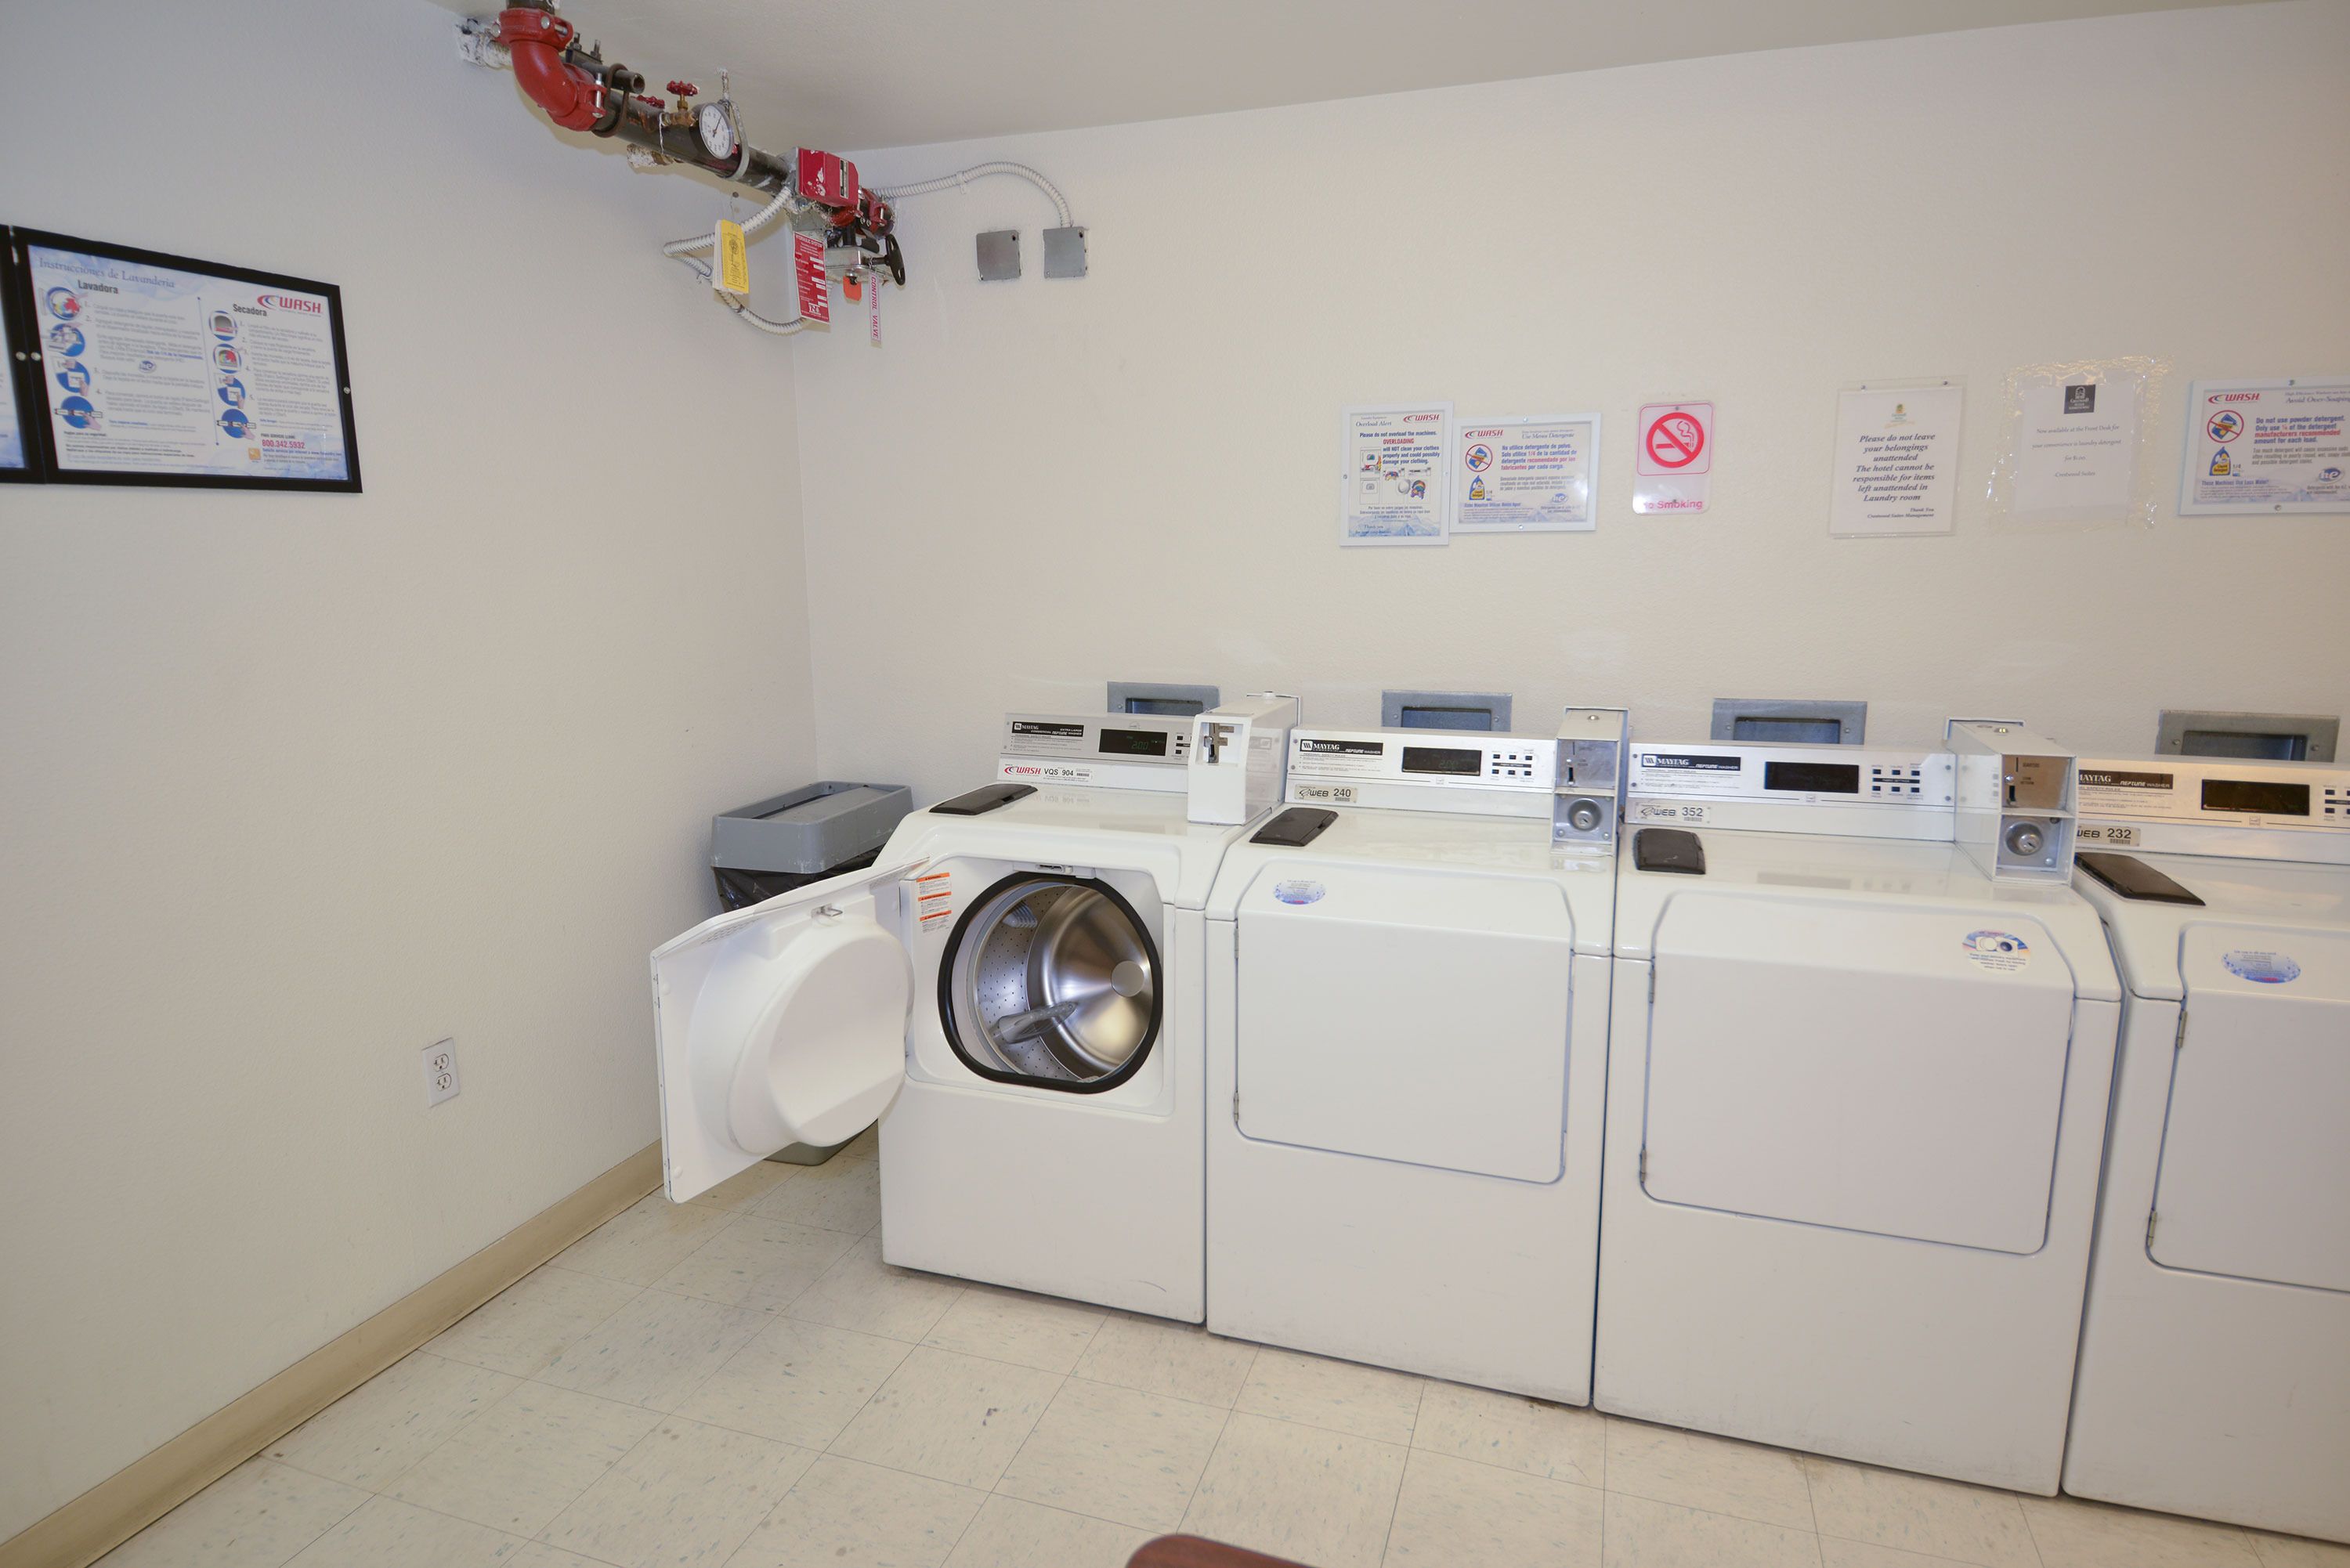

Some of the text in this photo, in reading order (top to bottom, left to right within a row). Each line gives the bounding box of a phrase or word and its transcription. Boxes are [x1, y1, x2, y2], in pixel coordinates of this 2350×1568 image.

[40, 258, 105, 276] Instrucciones
[108, 269, 119, 279] de
[78, 280, 119, 294] Lavadora
[233, 304, 267, 316] Secadora
[280, 297, 321, 313] WASH
[262, 439, 306, 449] 800.342.5932
[1863, 443, 1929, 454] your belongings
[1853, 475, 1897, 484] responsible
[1898, 474, 1912, 483] for
[1857, 485, 1871, 493] left
[1863, 494, 1897, 503] Laundry
[1658, 500, 1704, 510] Smoking
[1016, 766, 1042, 775] WASH
[1333, 788, 1351, 797] 240
[1653, 808, 1676, 817] WEB
[1682, 807, 1704, 817] 352
[2107, 827, 2131, 839] 232
